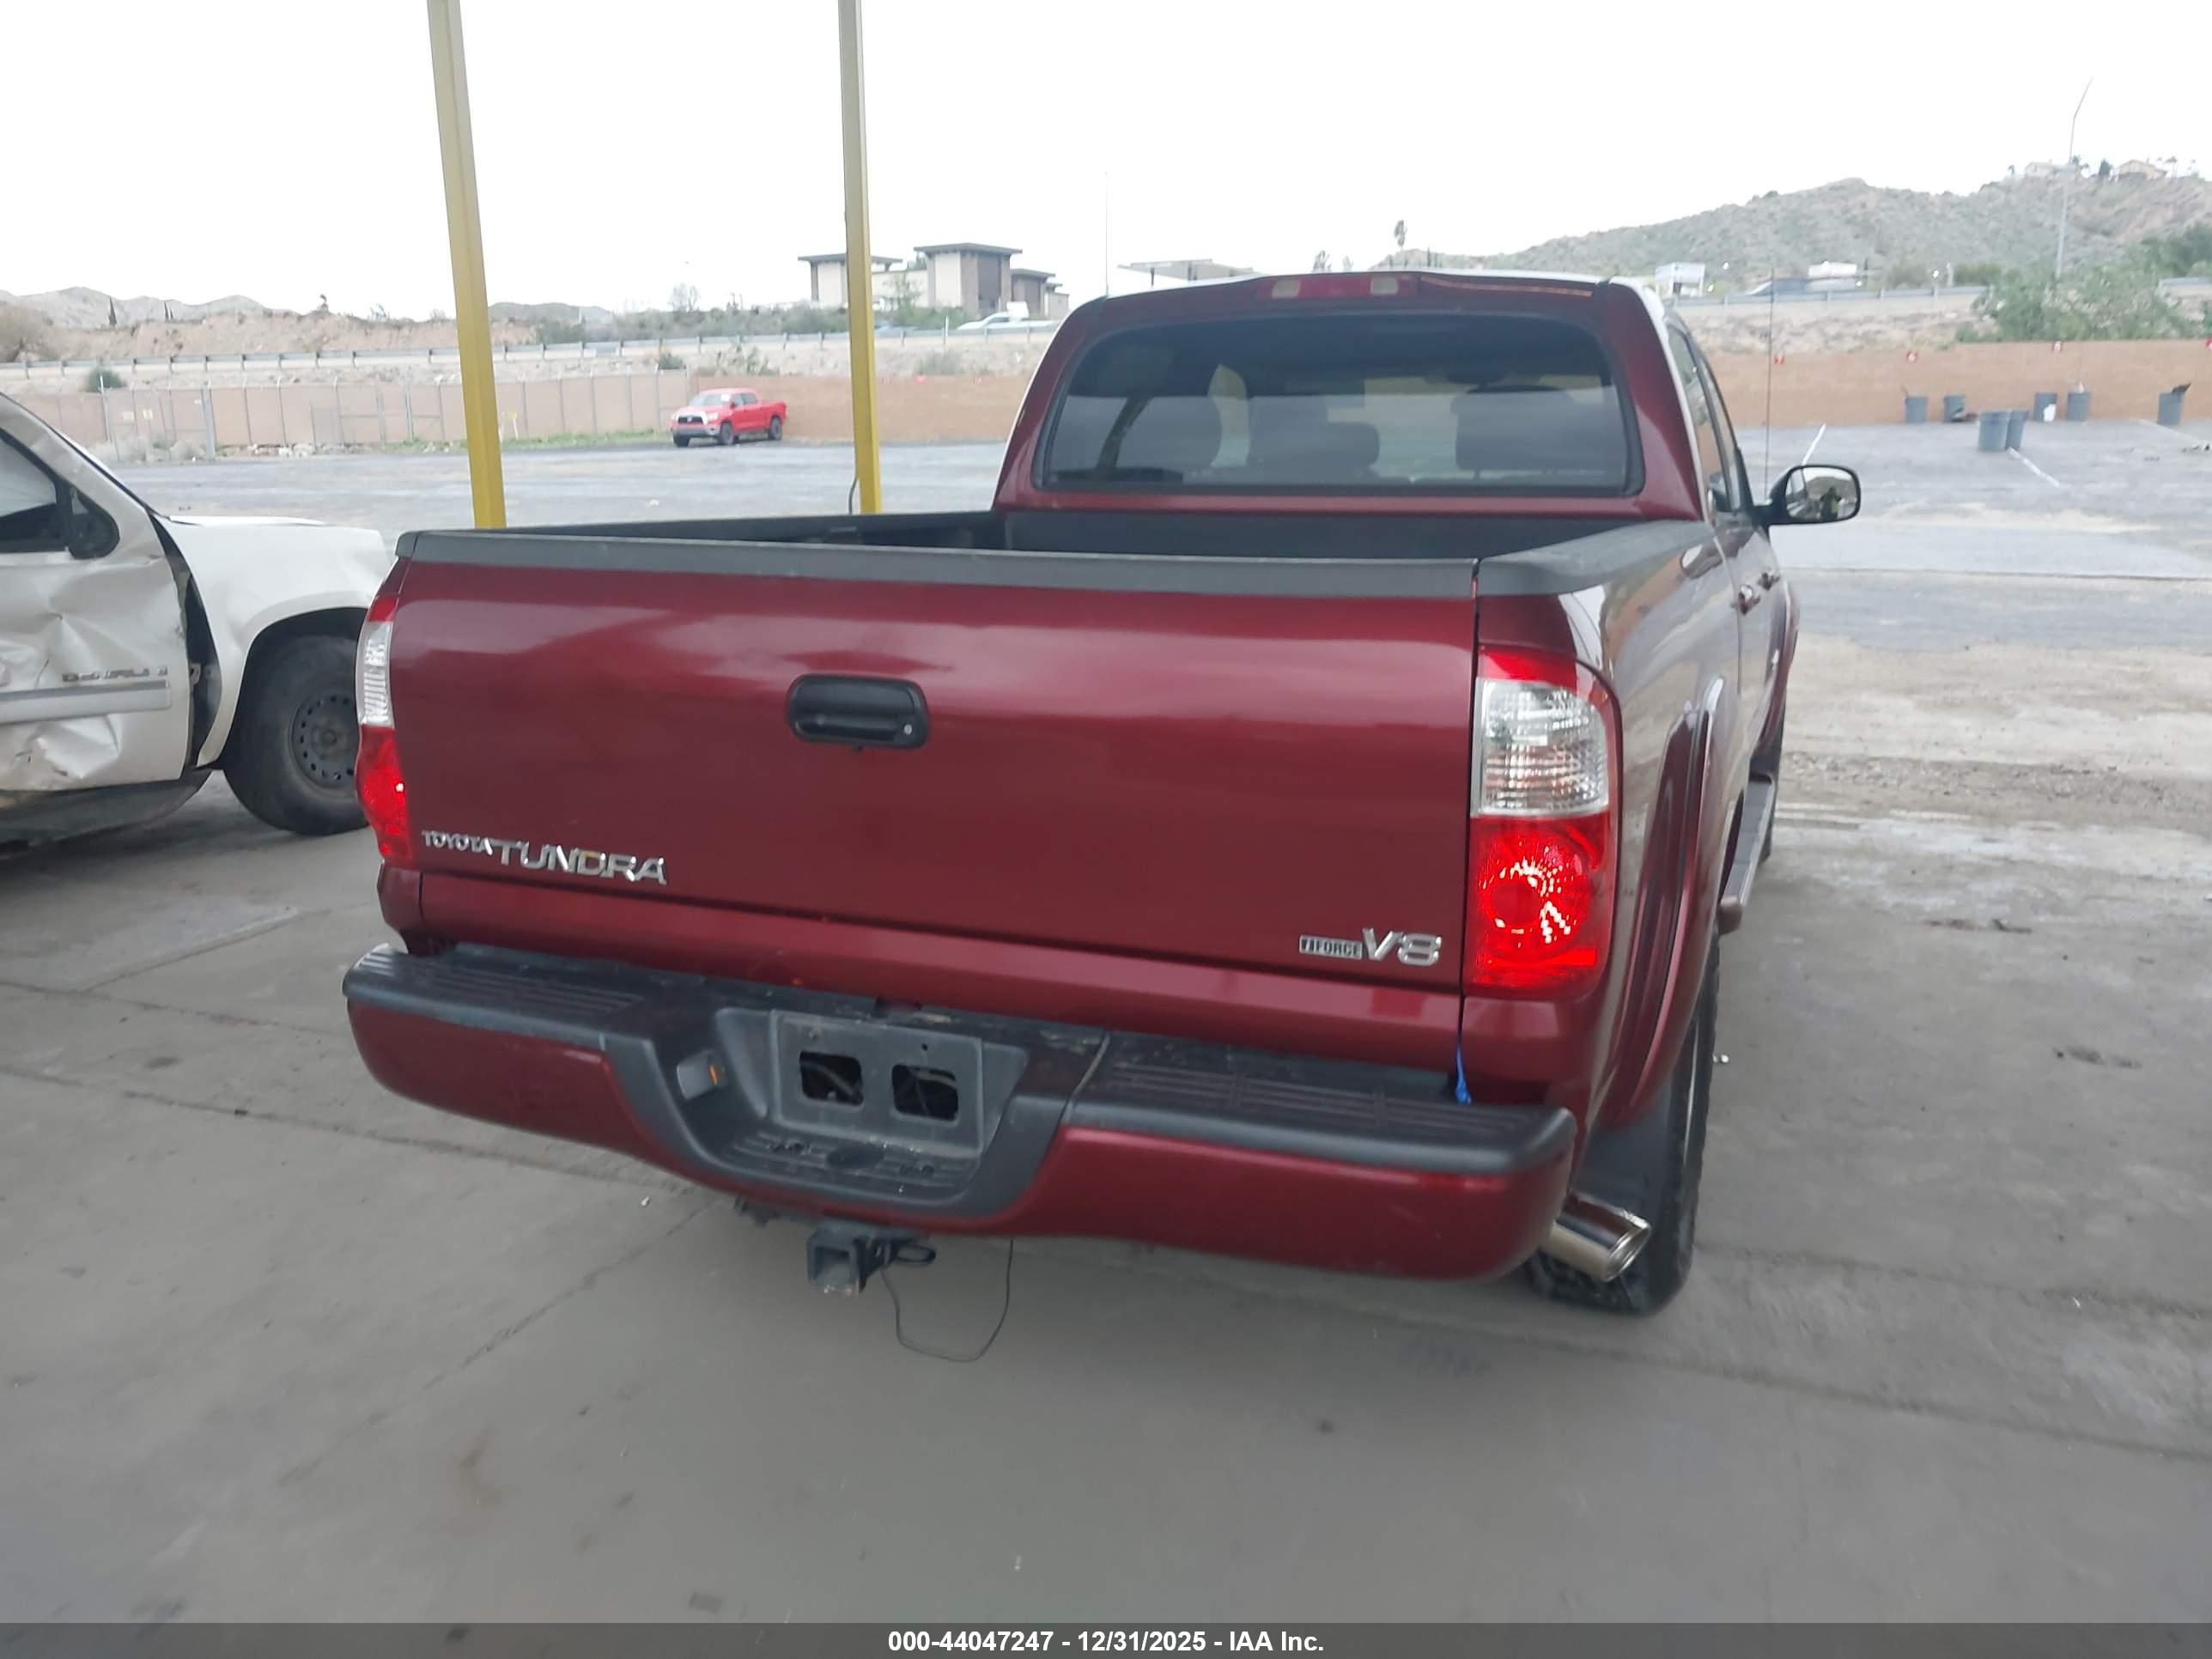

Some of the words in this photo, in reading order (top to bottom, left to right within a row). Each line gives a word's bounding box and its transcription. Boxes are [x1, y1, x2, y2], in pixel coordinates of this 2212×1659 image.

[422, 830, 493, 855] TOYOTA
[489, 837, 667, 885] TUNDRA
[1362, 927, 1443, 966] V8
